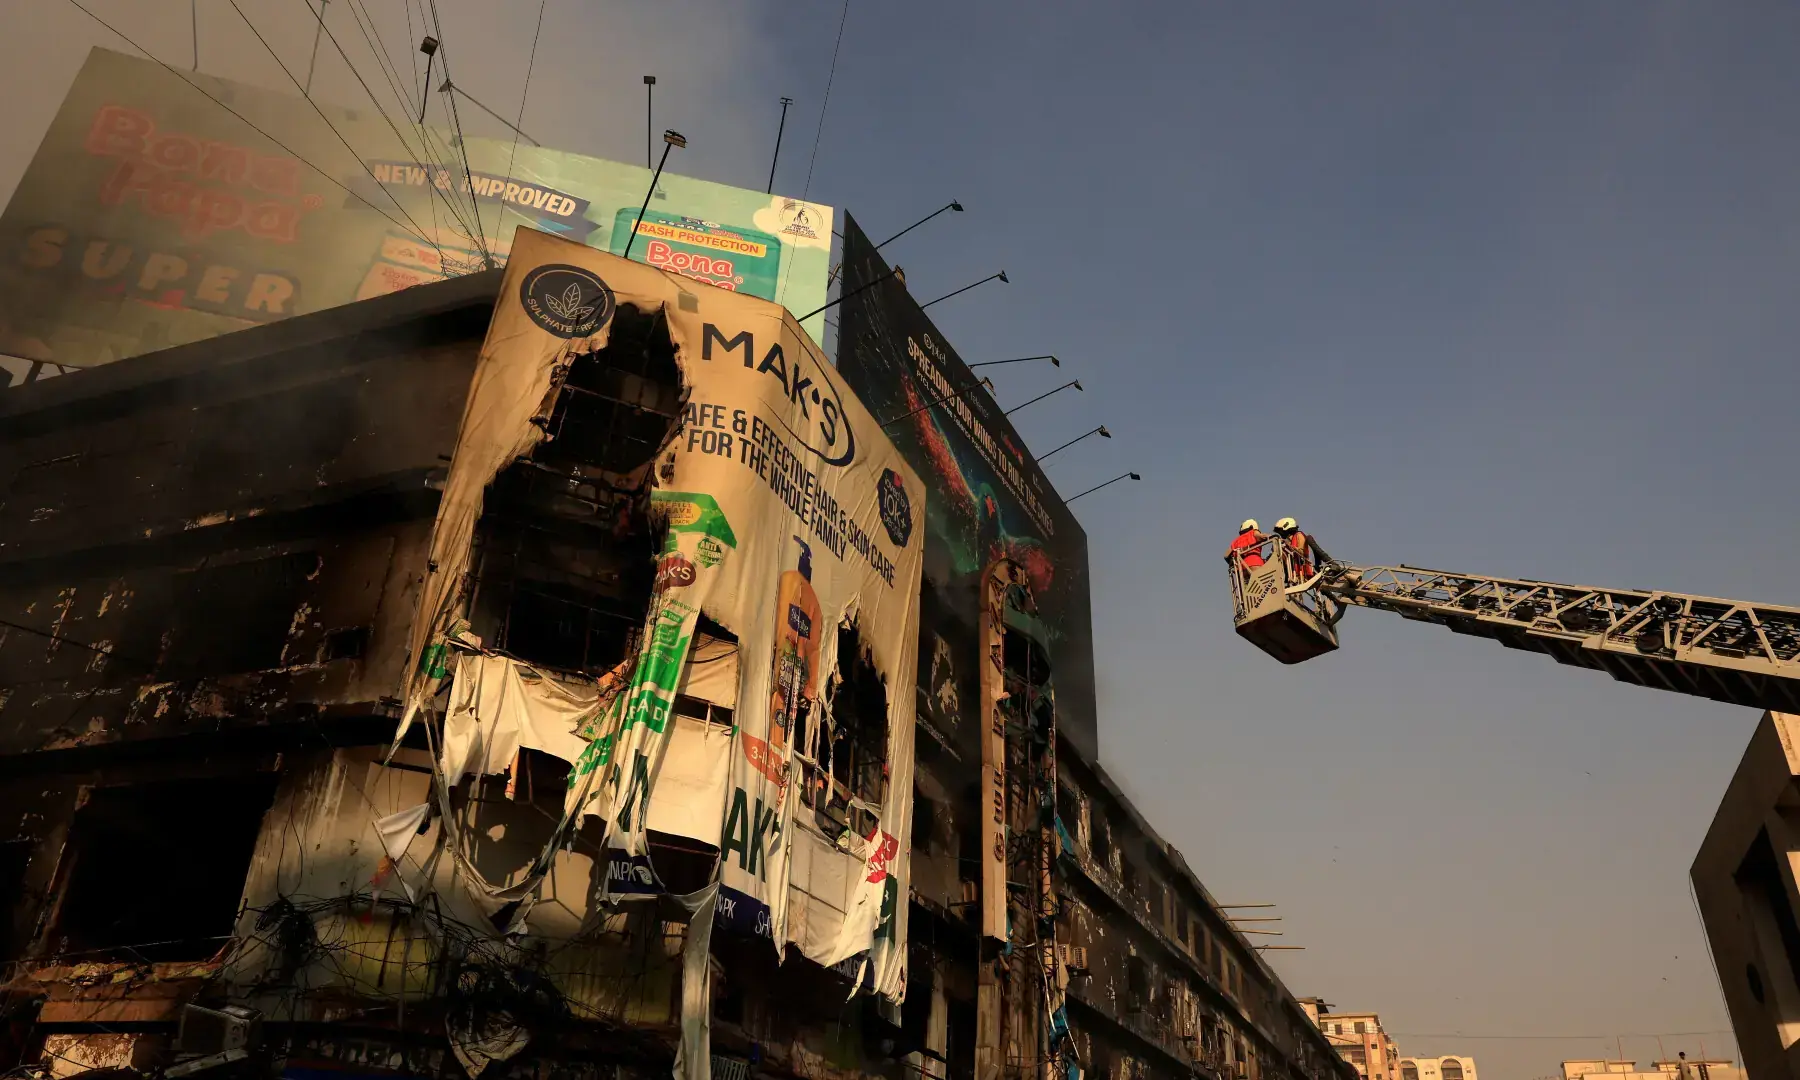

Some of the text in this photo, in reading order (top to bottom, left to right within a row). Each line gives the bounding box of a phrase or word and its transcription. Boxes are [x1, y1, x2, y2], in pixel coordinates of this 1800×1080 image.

[84, 103, 299, 196] Bona
[373, 163, 577, 218] NEW & IMPROVED
[20, 226, 295, 313] SUPER
[640, 221, 675, 239] RASH
[677, 230, 760, 255] PROTECTION
[646, 240, 734, 278] Bona
[527, 297, 574, 333] SULPHATE
[702, 322, 838, 447] MAK'S
[907, 336, 956, 408] SPREADING
[956, 396, 973, 430] OUR
[973, 416, 997, 462] WINGS
[998, 447, 1007, 473] TO
[683, 402, 896, 590] AFE & EFFECTIVE HAIR & SKIN CARE
[687, 429, 847, 564] FOR THE WHOLE FAMILY
[1254, 578, 1275, 608] MAGIRUS
